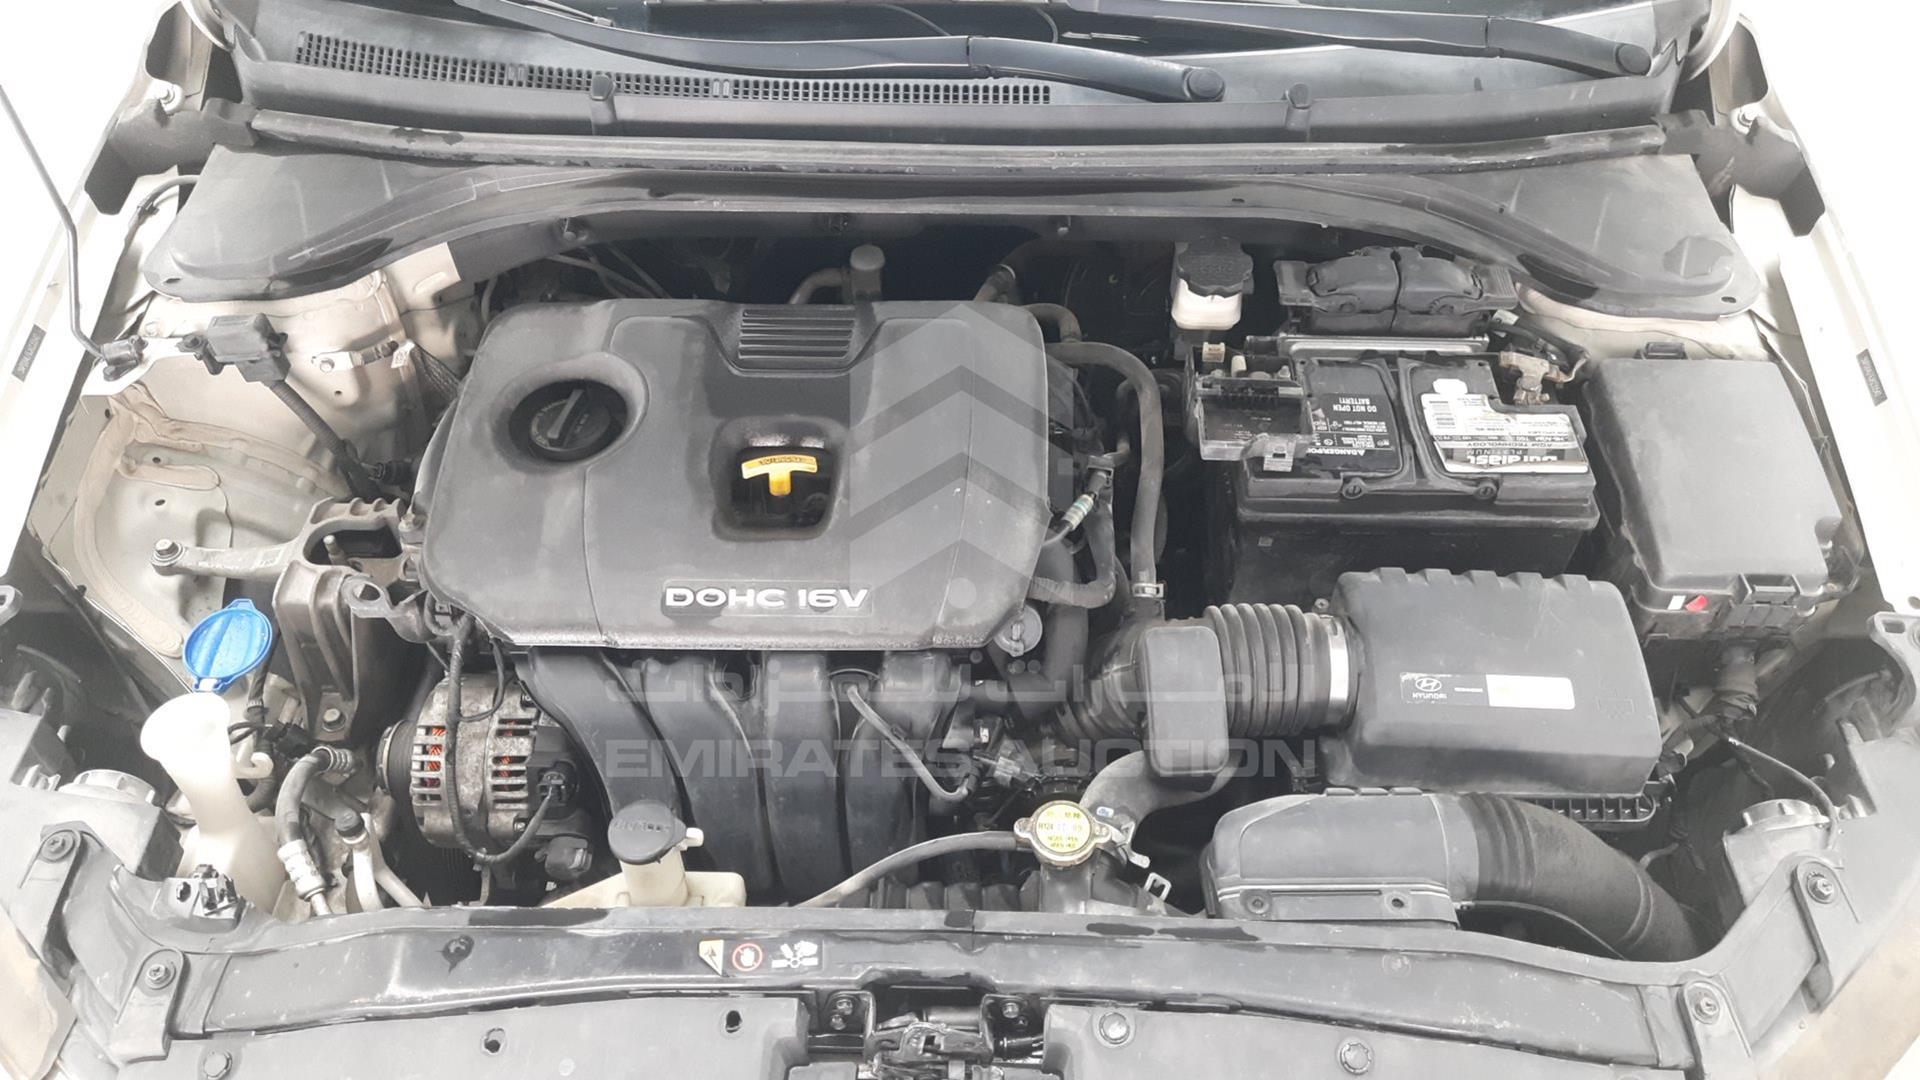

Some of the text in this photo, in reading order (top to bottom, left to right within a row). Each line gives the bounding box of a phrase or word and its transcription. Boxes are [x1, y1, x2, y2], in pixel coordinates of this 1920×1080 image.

[1333, 404, 1351, 412] OPEN
[665, 588, 868, 609] DOHC 16V
